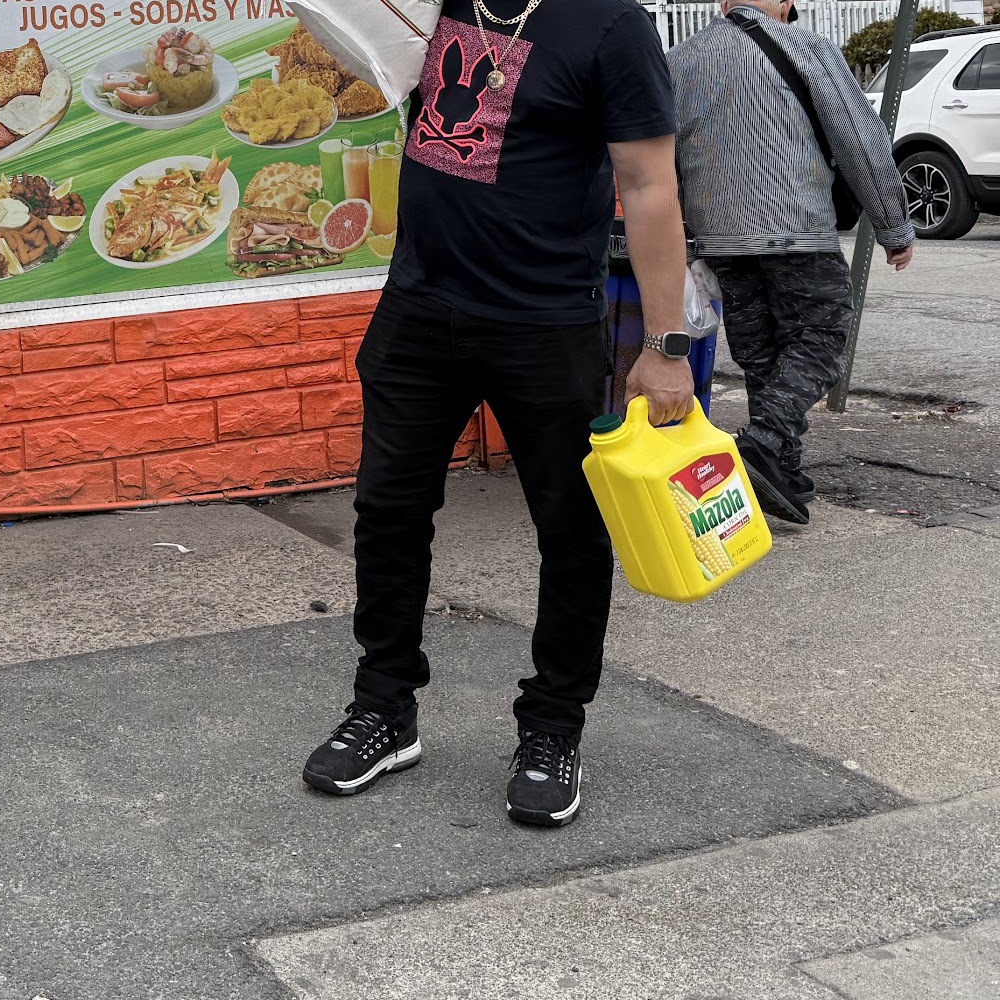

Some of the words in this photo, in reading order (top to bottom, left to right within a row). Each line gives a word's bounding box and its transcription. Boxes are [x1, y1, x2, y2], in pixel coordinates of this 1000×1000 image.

[19, 3, 106, 32] JUGOS
[697, 461, 711, 474] Heart
[688, 488, 745, 538] Mazola
[723, 516, 739, 529] CORN
